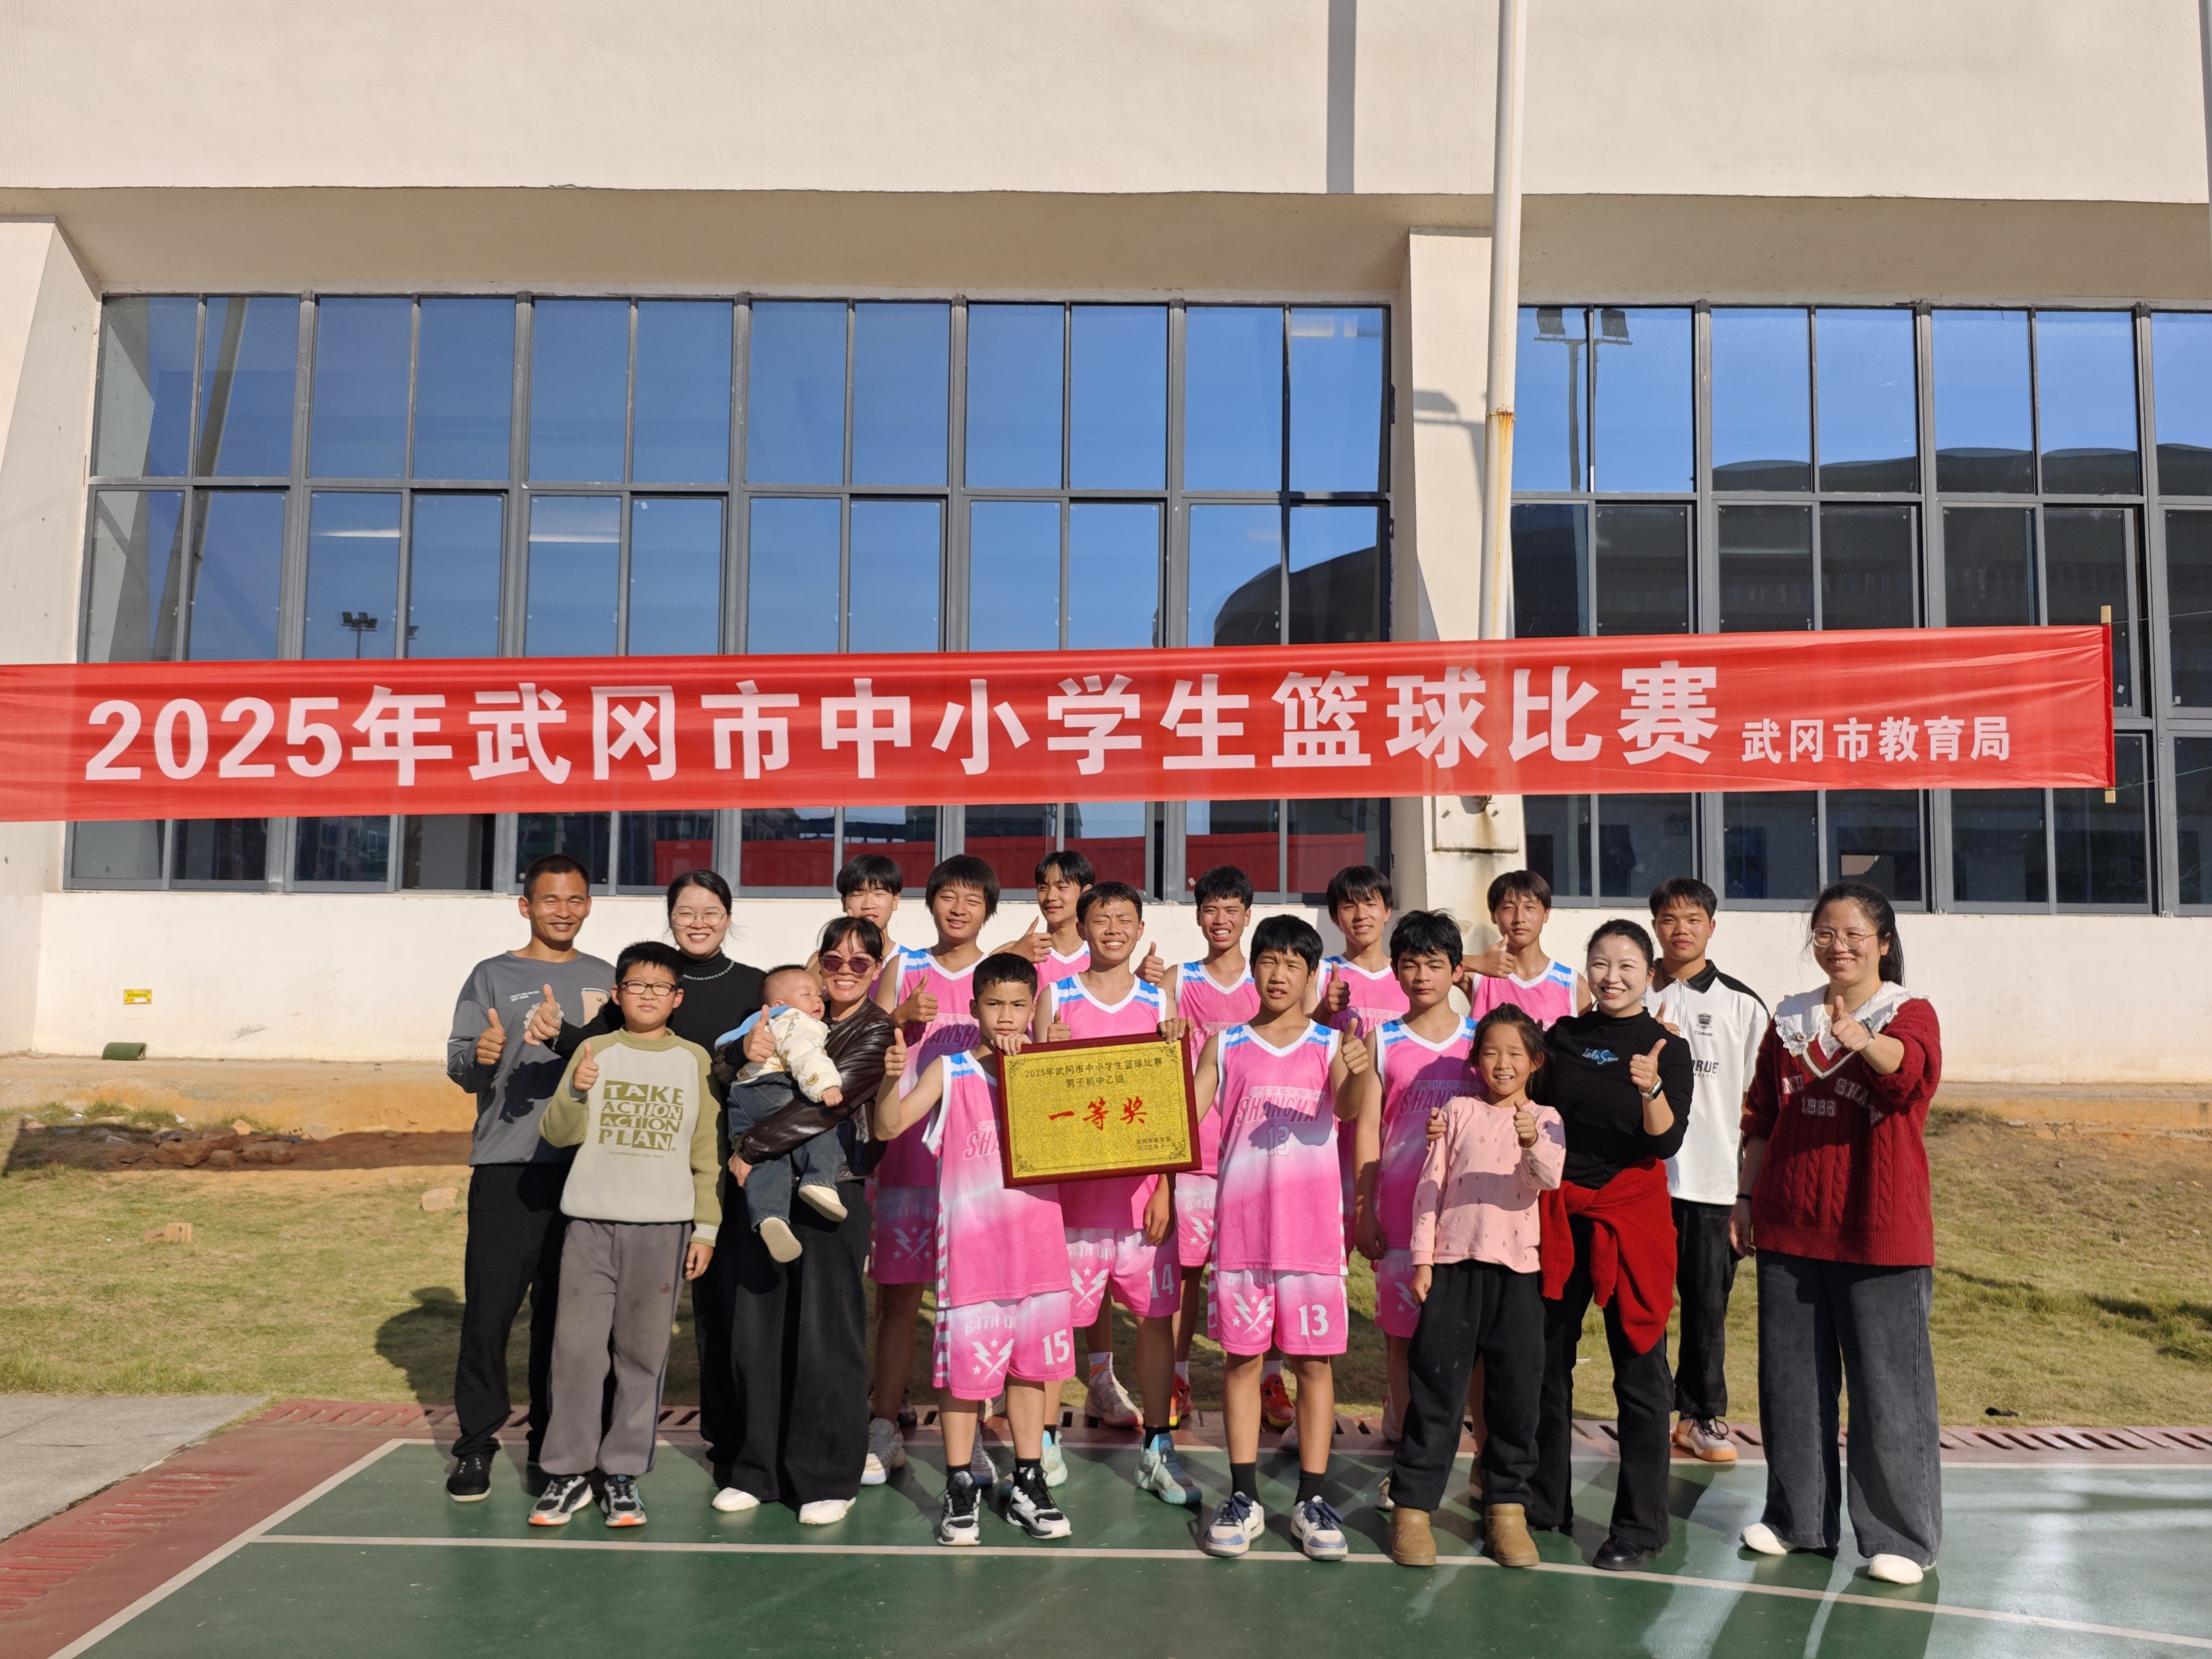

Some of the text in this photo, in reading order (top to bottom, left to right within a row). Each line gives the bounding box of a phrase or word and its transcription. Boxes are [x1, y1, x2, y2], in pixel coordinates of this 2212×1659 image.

[85, 660, 1718, 786] 2025年武冈市中小学生篮球比赛
[1742, 716, 2009, 764] 武冈市教育局
[1024, 1057, 1163, 1077] 2025年武冈市中小学生篮球比赛
[605, 1084, 684, 1105] TAKE
[1250, 1087, 1278, 1095] SUPERSTAR
[1279, 1087, 1311, 1097] BASKETBALL
[602, 1101, 683, 1120] ACTION
[602, 1115, 681, 1133] ACTION
[1048, 1096, 1147, 1130] 一等奖
[1235, 1096, 1324, 1125] SHANGHAI
[598, 1128, 671, 1151] PLAN
[1267, 1125, 1290, 1156] 13
[1147, 1263, 1174, 1298] 14
[1298, 1304, 1328, 1336] 13
[1042, 1328, 1070, 1365] 15
